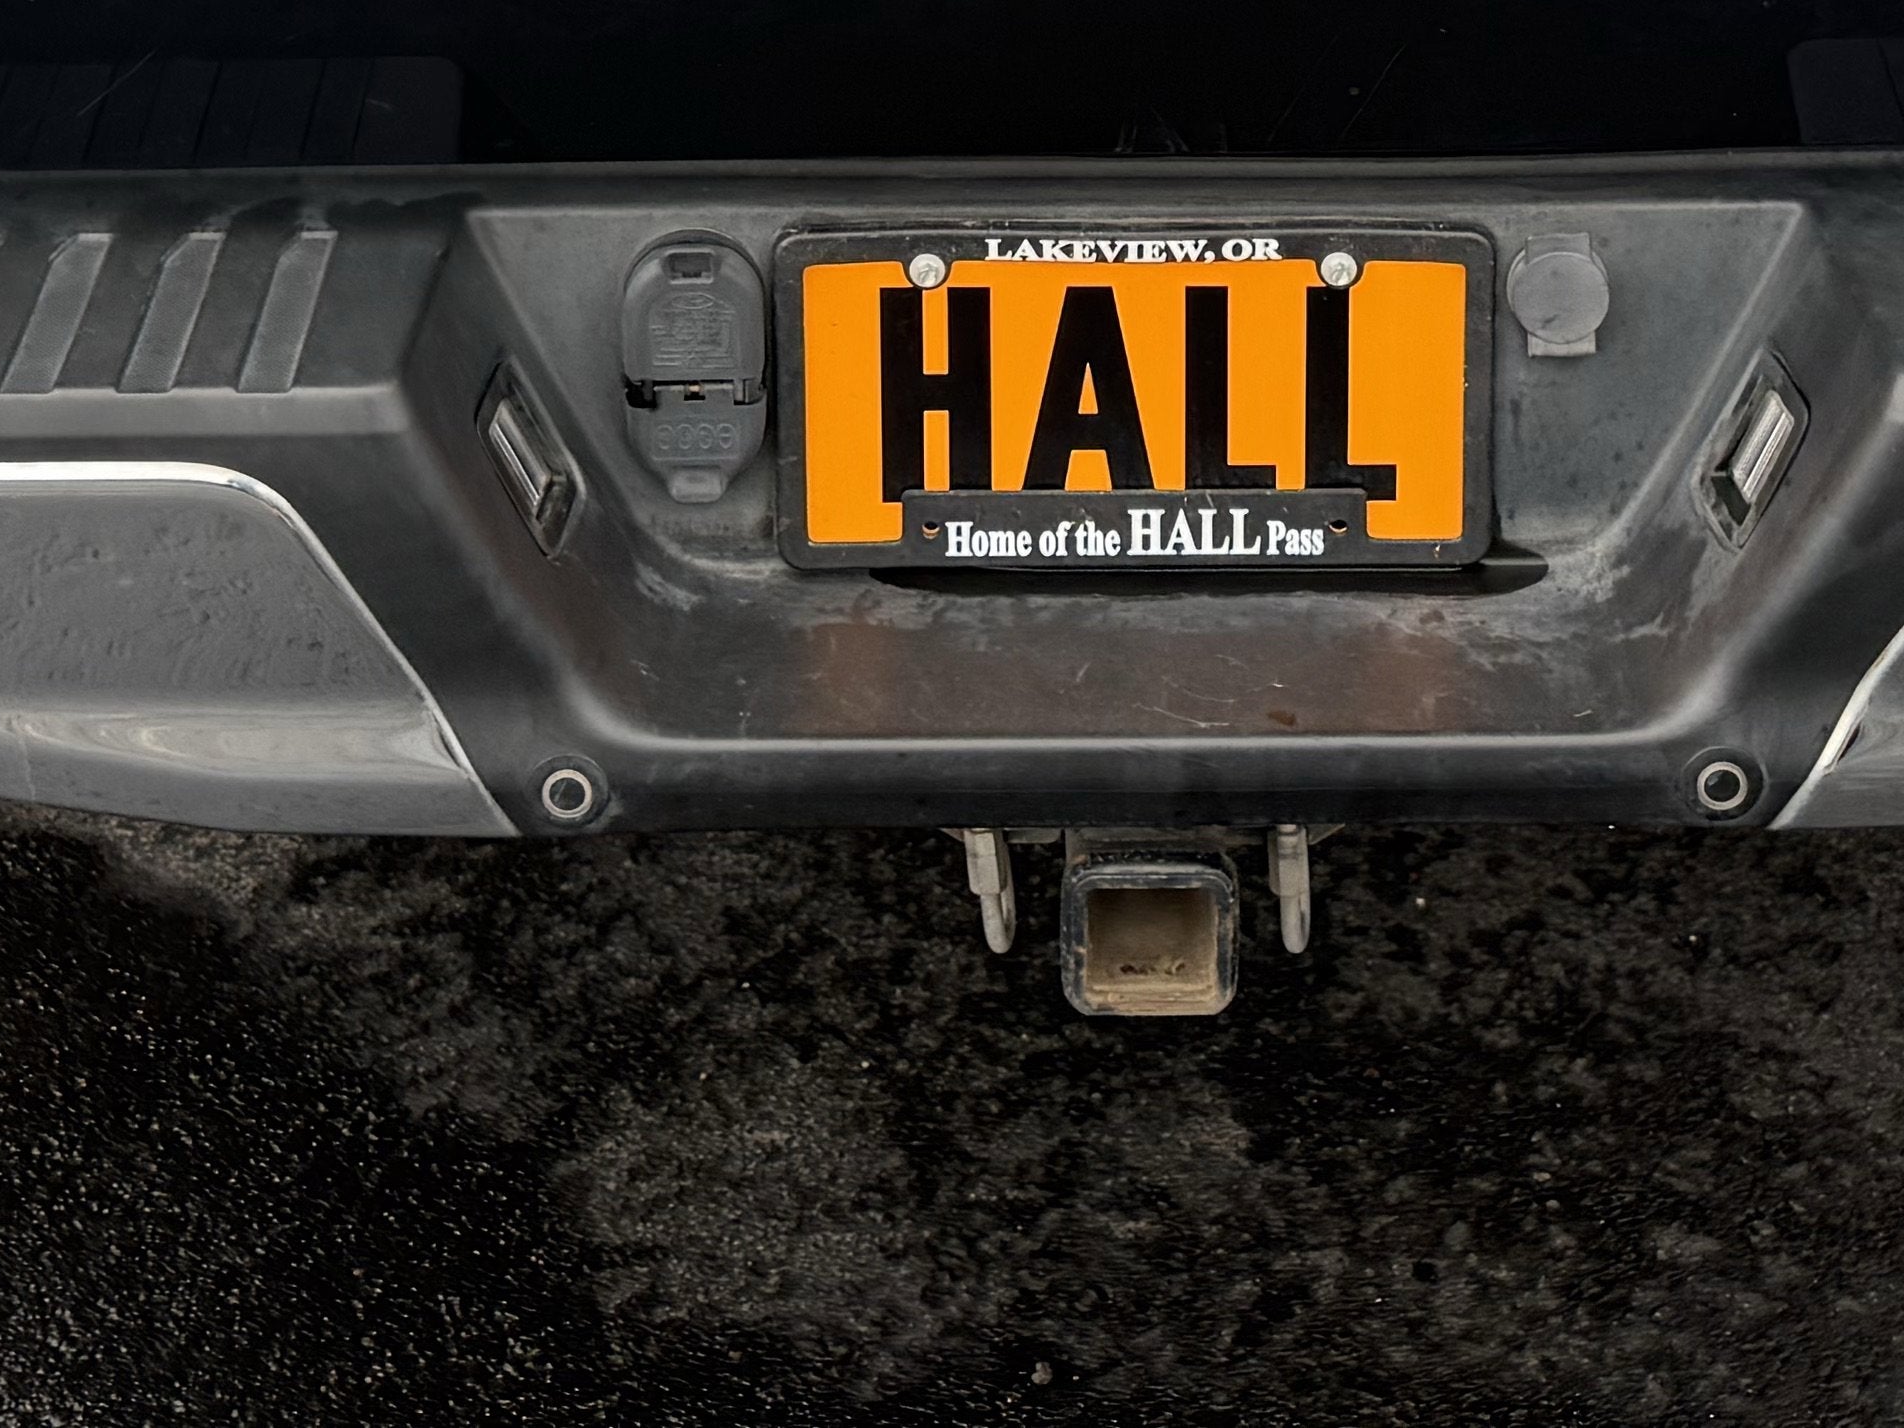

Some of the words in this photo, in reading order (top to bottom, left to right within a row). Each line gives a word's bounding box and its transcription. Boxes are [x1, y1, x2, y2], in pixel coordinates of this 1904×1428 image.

[984, 239, 1215, 265] LAKEVIEW,
[1222, 238, 1283, 261] OR
[879, 285, 1398, 503] HALL
[945, 521, 1032, 558] Home
[1038, 519, 1074, 556] of
[1075, 519, 1121, 557] the
[1127, 508, 1260, 556] HALL
[1266, 522, 1324, 556] Pass
